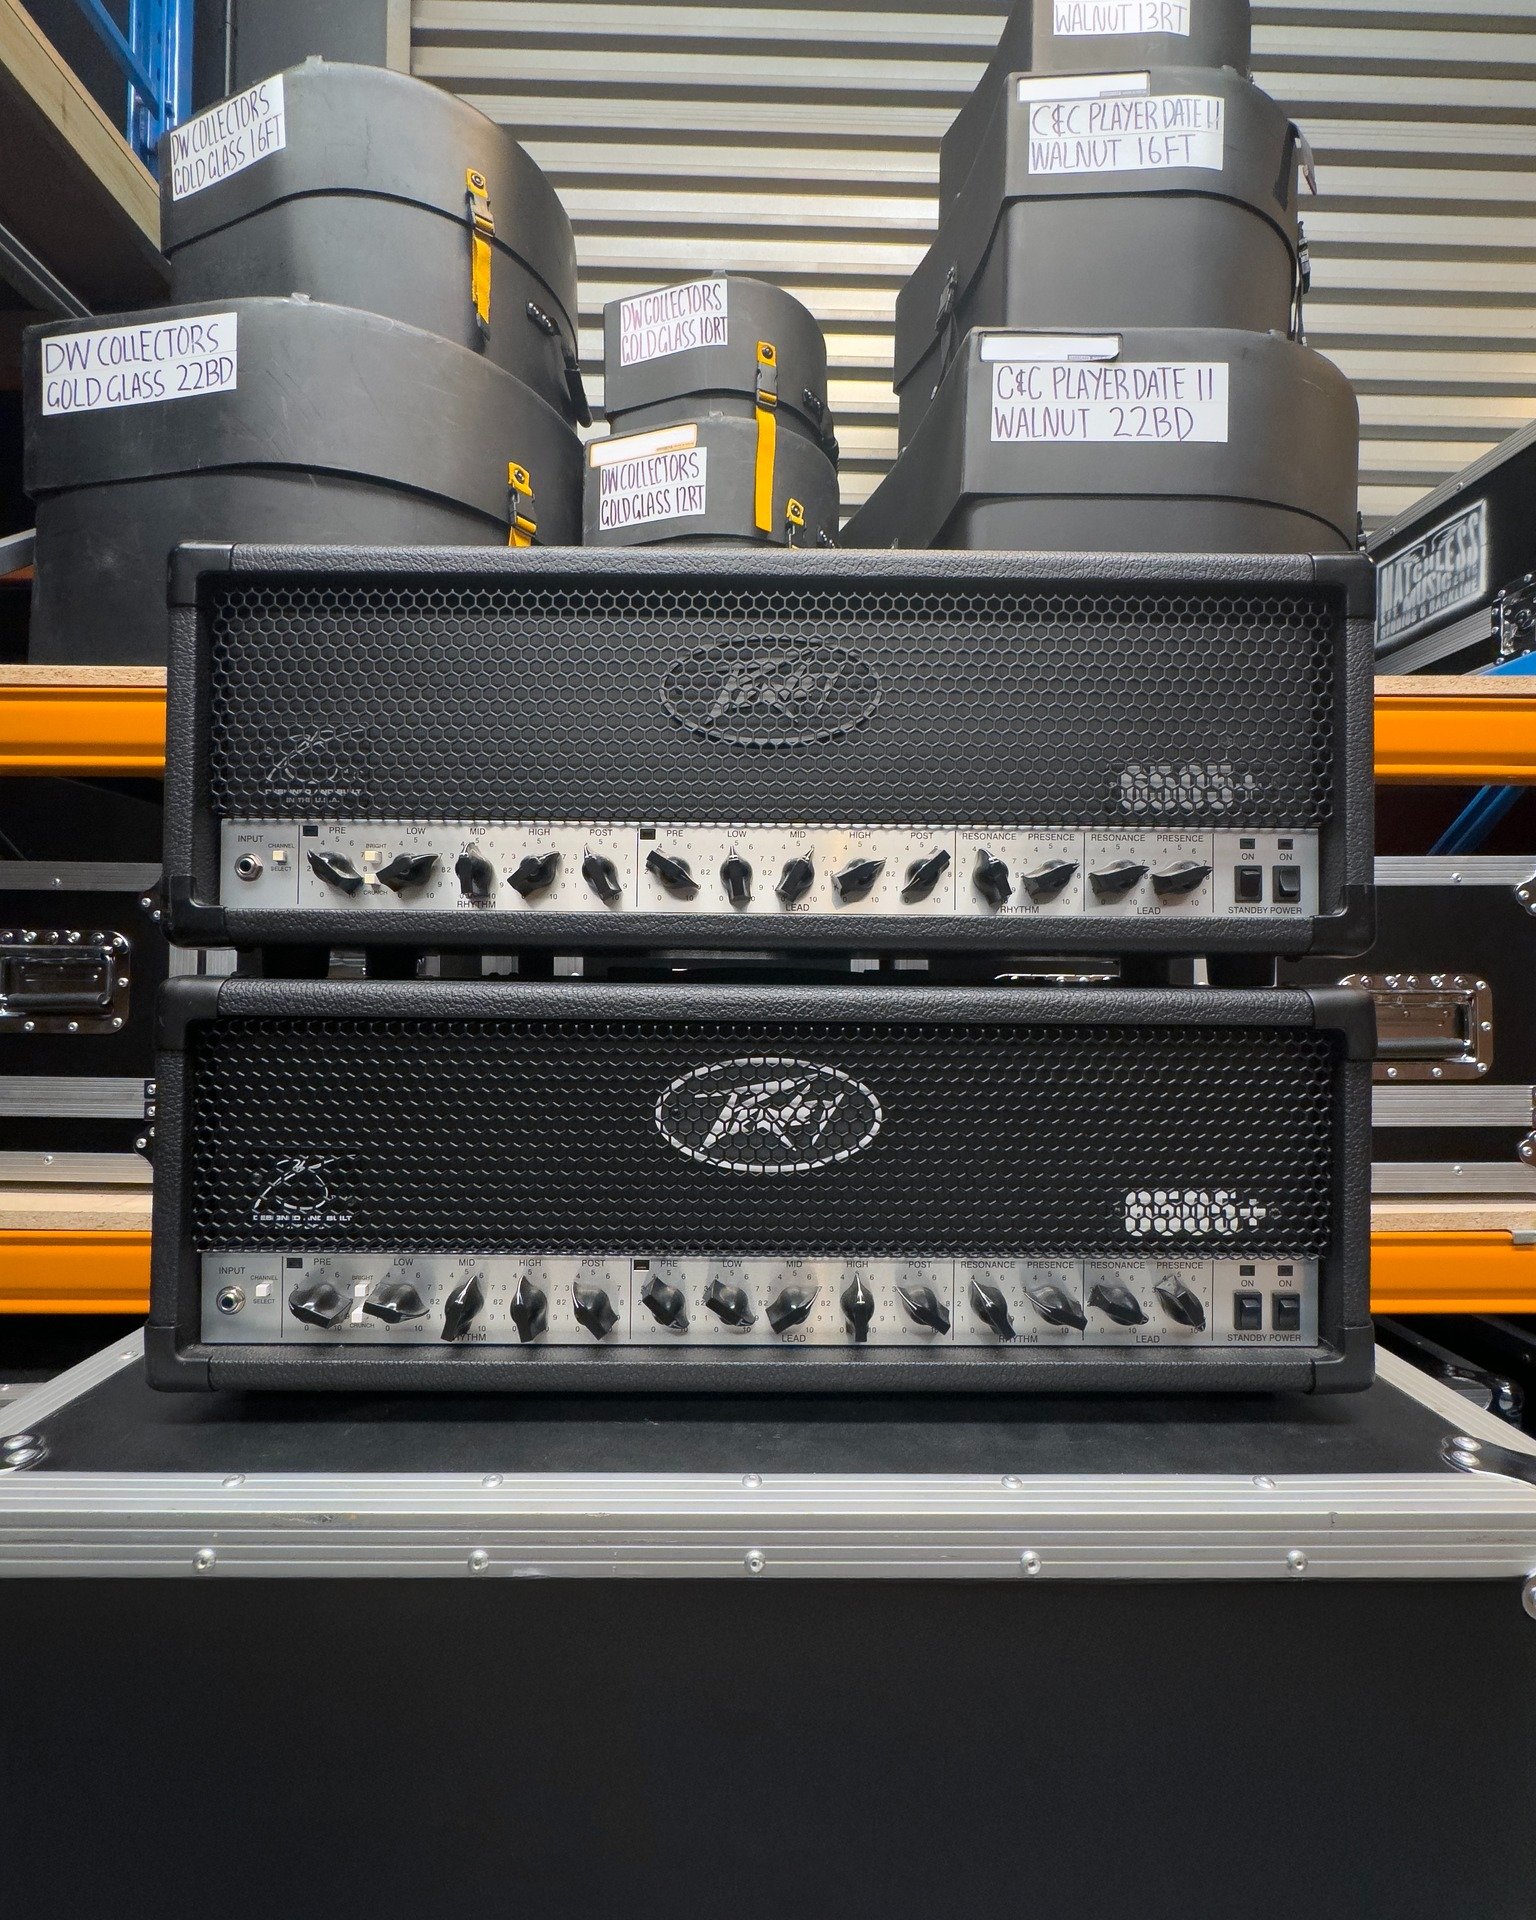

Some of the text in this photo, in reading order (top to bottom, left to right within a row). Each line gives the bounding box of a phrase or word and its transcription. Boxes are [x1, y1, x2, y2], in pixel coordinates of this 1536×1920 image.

[1055, 3, 1187, 33] WALNUT 13RT
[172, 84, 270, 165] DW COLLECTORS
[1032, 103, 1080, 137] C&C
[1089, 100, 1158, 133] PLAYER
[1163, 98, 1201, 128] DATE
[174, 113, 282, 195] GOLD GLASS 16FT
[1031, 133, 1196, 171] WALNUT 16FT
[621, 283, 722, 333] DW COLLECTORS
[45, 323, 219, 374] DW COLLECTORS
[621, 316, 728, 364] GOLD GLASS 10RT
[47, 356, 233, 410] GOLD GLASS 22BD
[997, 365, 1043, 401] C&C
[1053, 366, 1129, 401] PLAYER
[1134, 366, 1186, 401] DATE
[995, 406, 1194, 441] WALNUT 22BD
[601, 452, 700, 495] DW COLLECTORS
[601, 484, 705, 527] GOLD GLASS 12RT
[1381, 511, 1479, 611] MATCHLESS
[1380, 608, 1417, 640] STUDIOS
[1428, 577, 1477, 614] BACKLINE
[1402, 570, 1451, 613] MUSIC
[667, 829, 683, 837] PRE
[1028, 833, 1075, 841] PRESENCE
[1091, 834, 1145, 842] RESONANCE
[457, 901, 496, 909] RHYTHM
[1137, 907, 1161, 915] LEAD
[1228, 906, 1268, 914] STANDBY
[218, 1266, 245, 1275] INPUT
[1026, 1261, 1074, 1269] PRESENCE
[1156, 1261, 1203, 1269] PRESENCE
[1269, 1333, 1301, 1341] POWER
